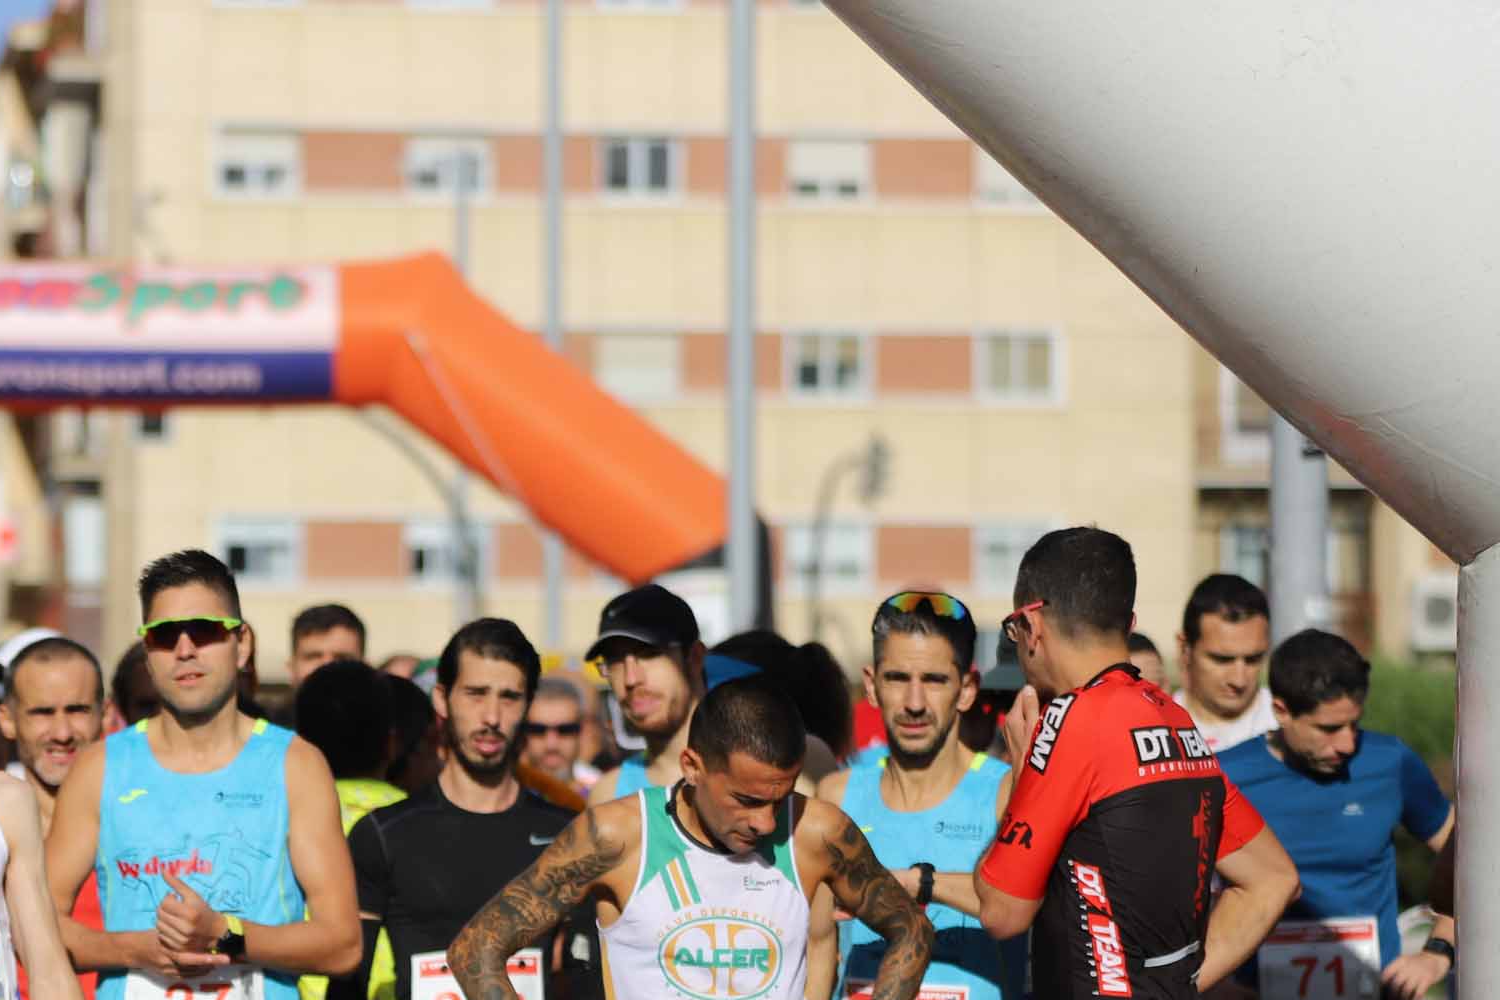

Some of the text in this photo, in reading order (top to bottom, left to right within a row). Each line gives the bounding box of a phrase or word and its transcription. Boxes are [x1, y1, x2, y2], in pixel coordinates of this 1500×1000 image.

[1030, 695, 1075, 772] TEAM
[1134, 729, 1213, 762] DT TEA
[673, 948, 771, 973] ALCER
[1091, 920, 1128, 993] TEAM
[1291, 955, 1344, 998] 71
